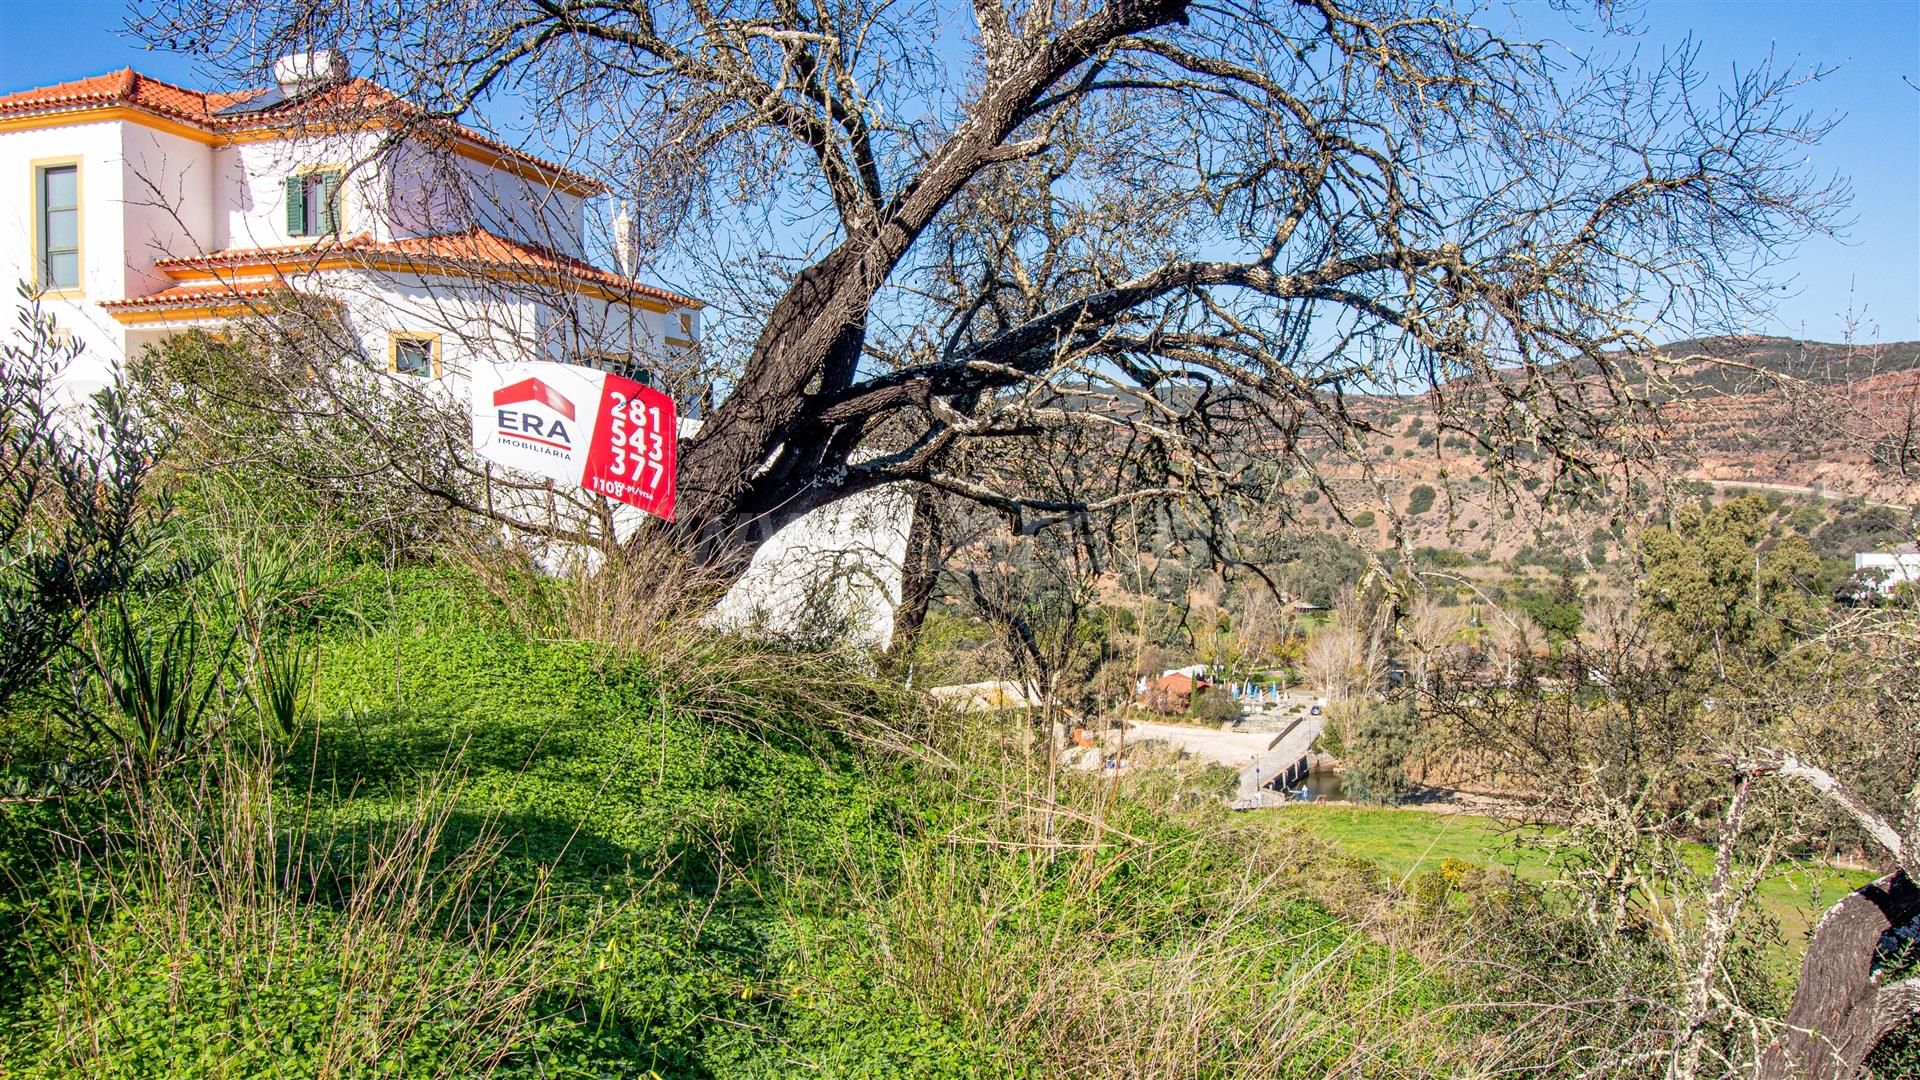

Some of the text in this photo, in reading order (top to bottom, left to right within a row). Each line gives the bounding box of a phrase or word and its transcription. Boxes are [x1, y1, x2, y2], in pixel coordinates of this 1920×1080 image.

[498, 409, 572, 444] ERA
[610, 391, 660, 433] 281
[498, 437, 572, 461] IMOBILIÁRIA
[611, 419, 663, 461] 543
[610, 446, 664, 489] 377
